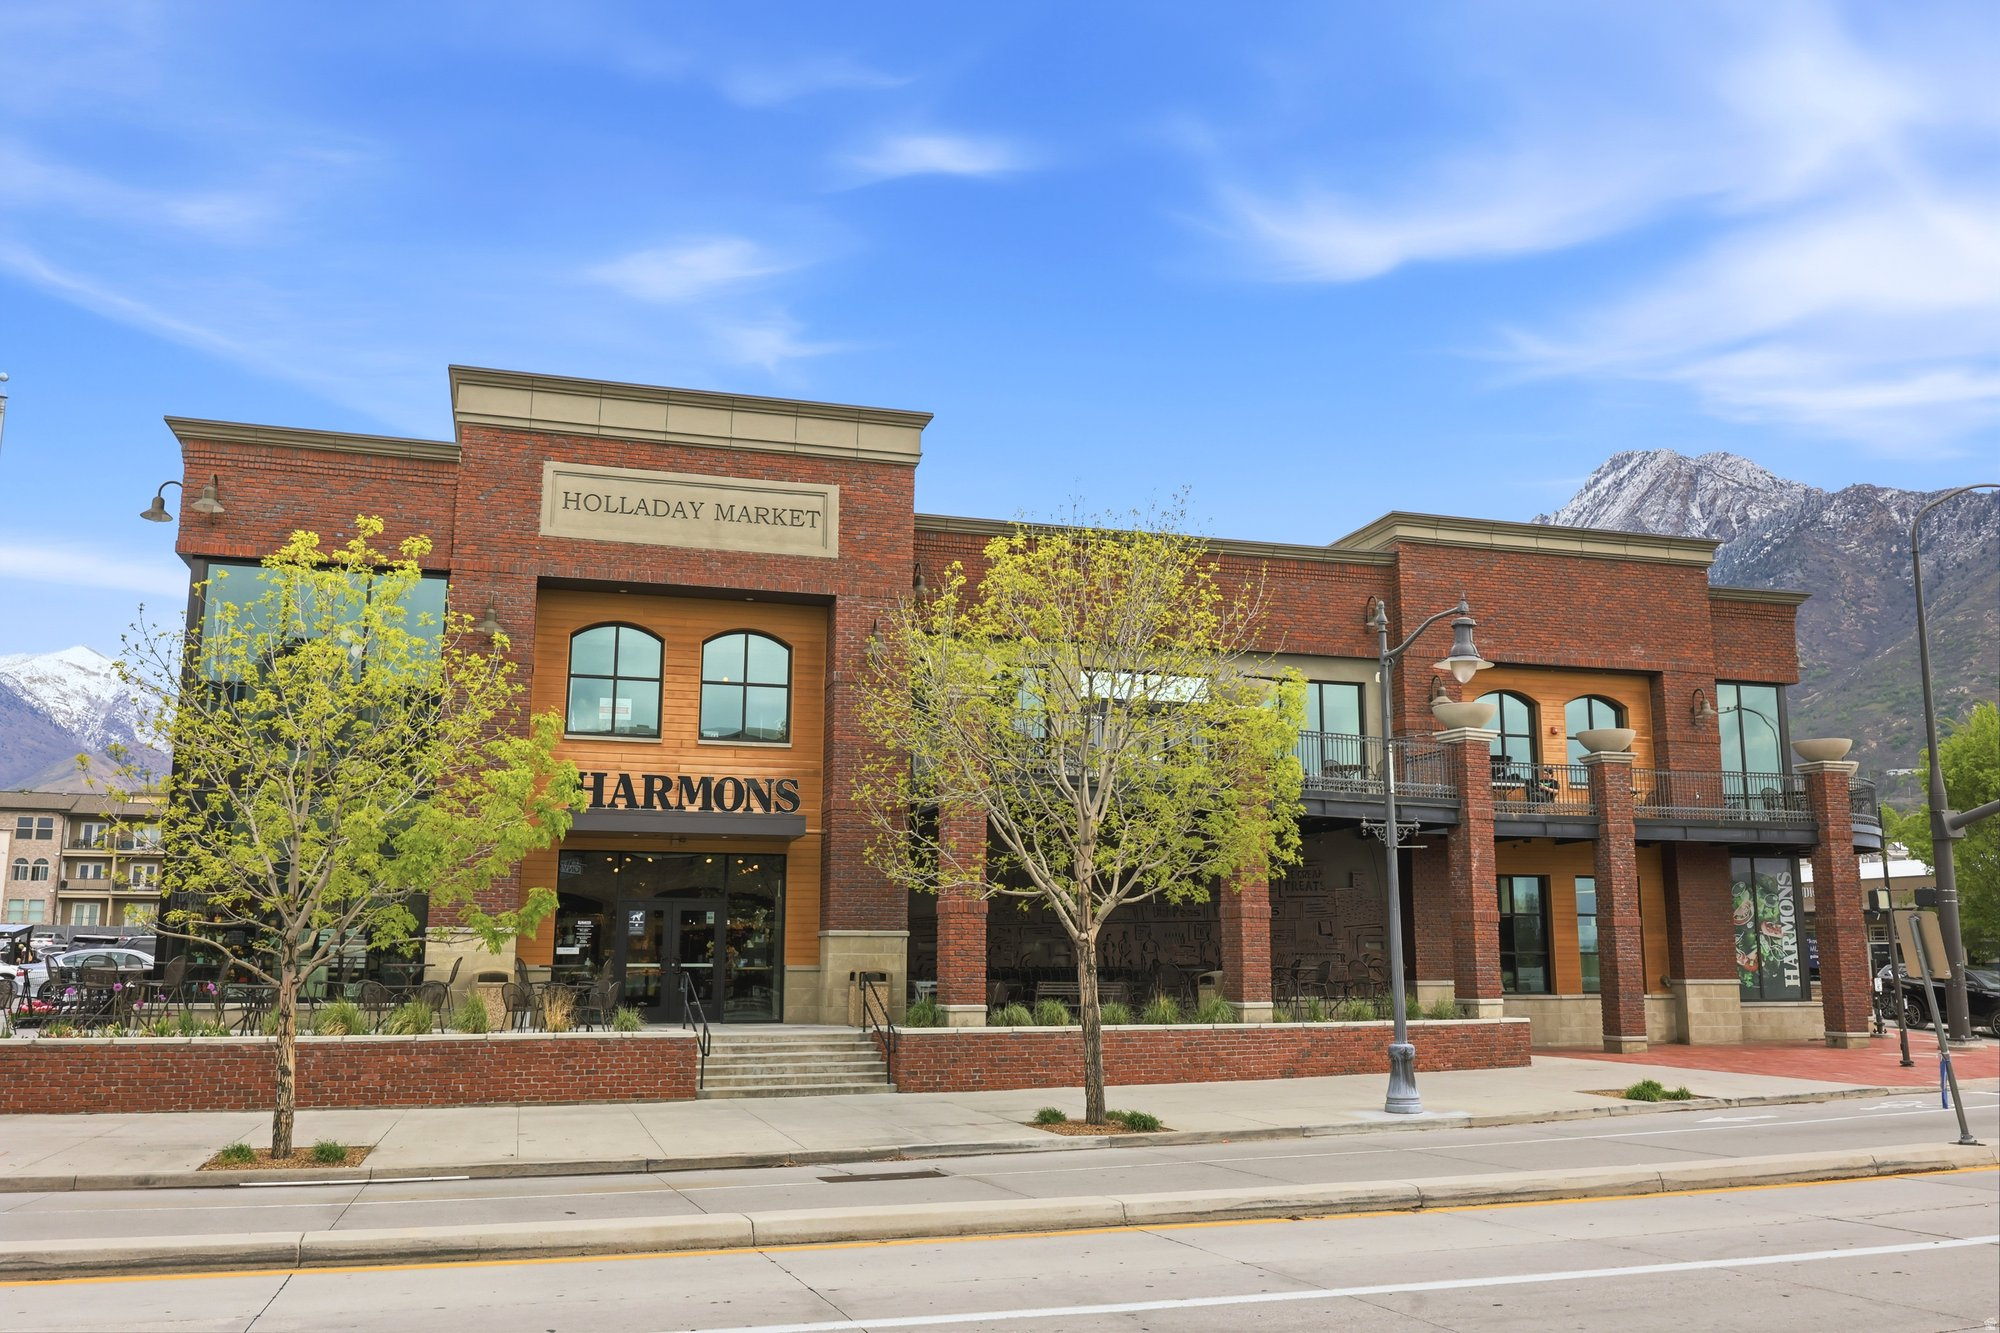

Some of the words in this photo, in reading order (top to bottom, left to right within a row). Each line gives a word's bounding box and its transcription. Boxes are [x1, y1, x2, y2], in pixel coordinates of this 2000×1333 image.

[562, 491, 705, 520] HOLLADAY
[714, 503, 821, 528] MARKET
[574, 772, 801, 814] HARMONS
[1283, 880, 1325, 892] TREATS
[1777, 871, 1800, 988] HARMONS
